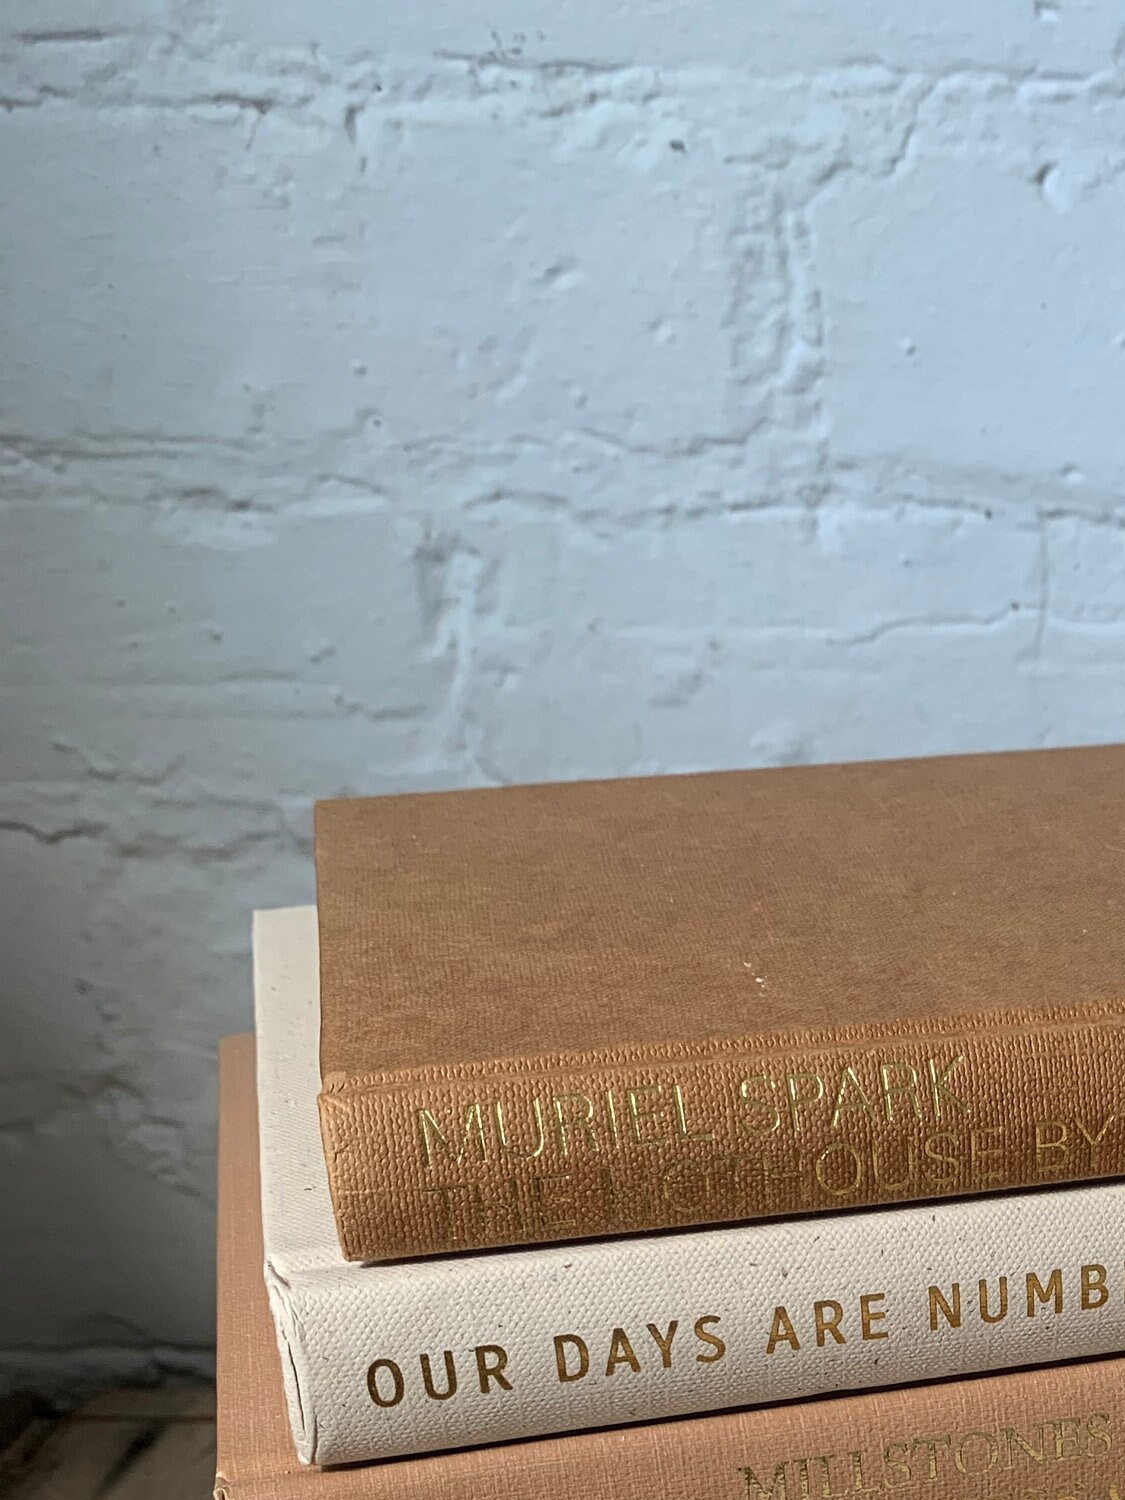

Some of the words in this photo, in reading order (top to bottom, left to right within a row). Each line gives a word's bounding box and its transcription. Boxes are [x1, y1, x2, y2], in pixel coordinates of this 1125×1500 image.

[417, 1083, 713, 1169] MURIEL
[740, 1056, 972, 1137] SPARK
[1034, 1115, 1114, 1173] BY
[366, 1344, 515, 1408] OUR
[555, 1314, 728, 1382] DAYS
[765, 1293, 891, 1356] ARE
